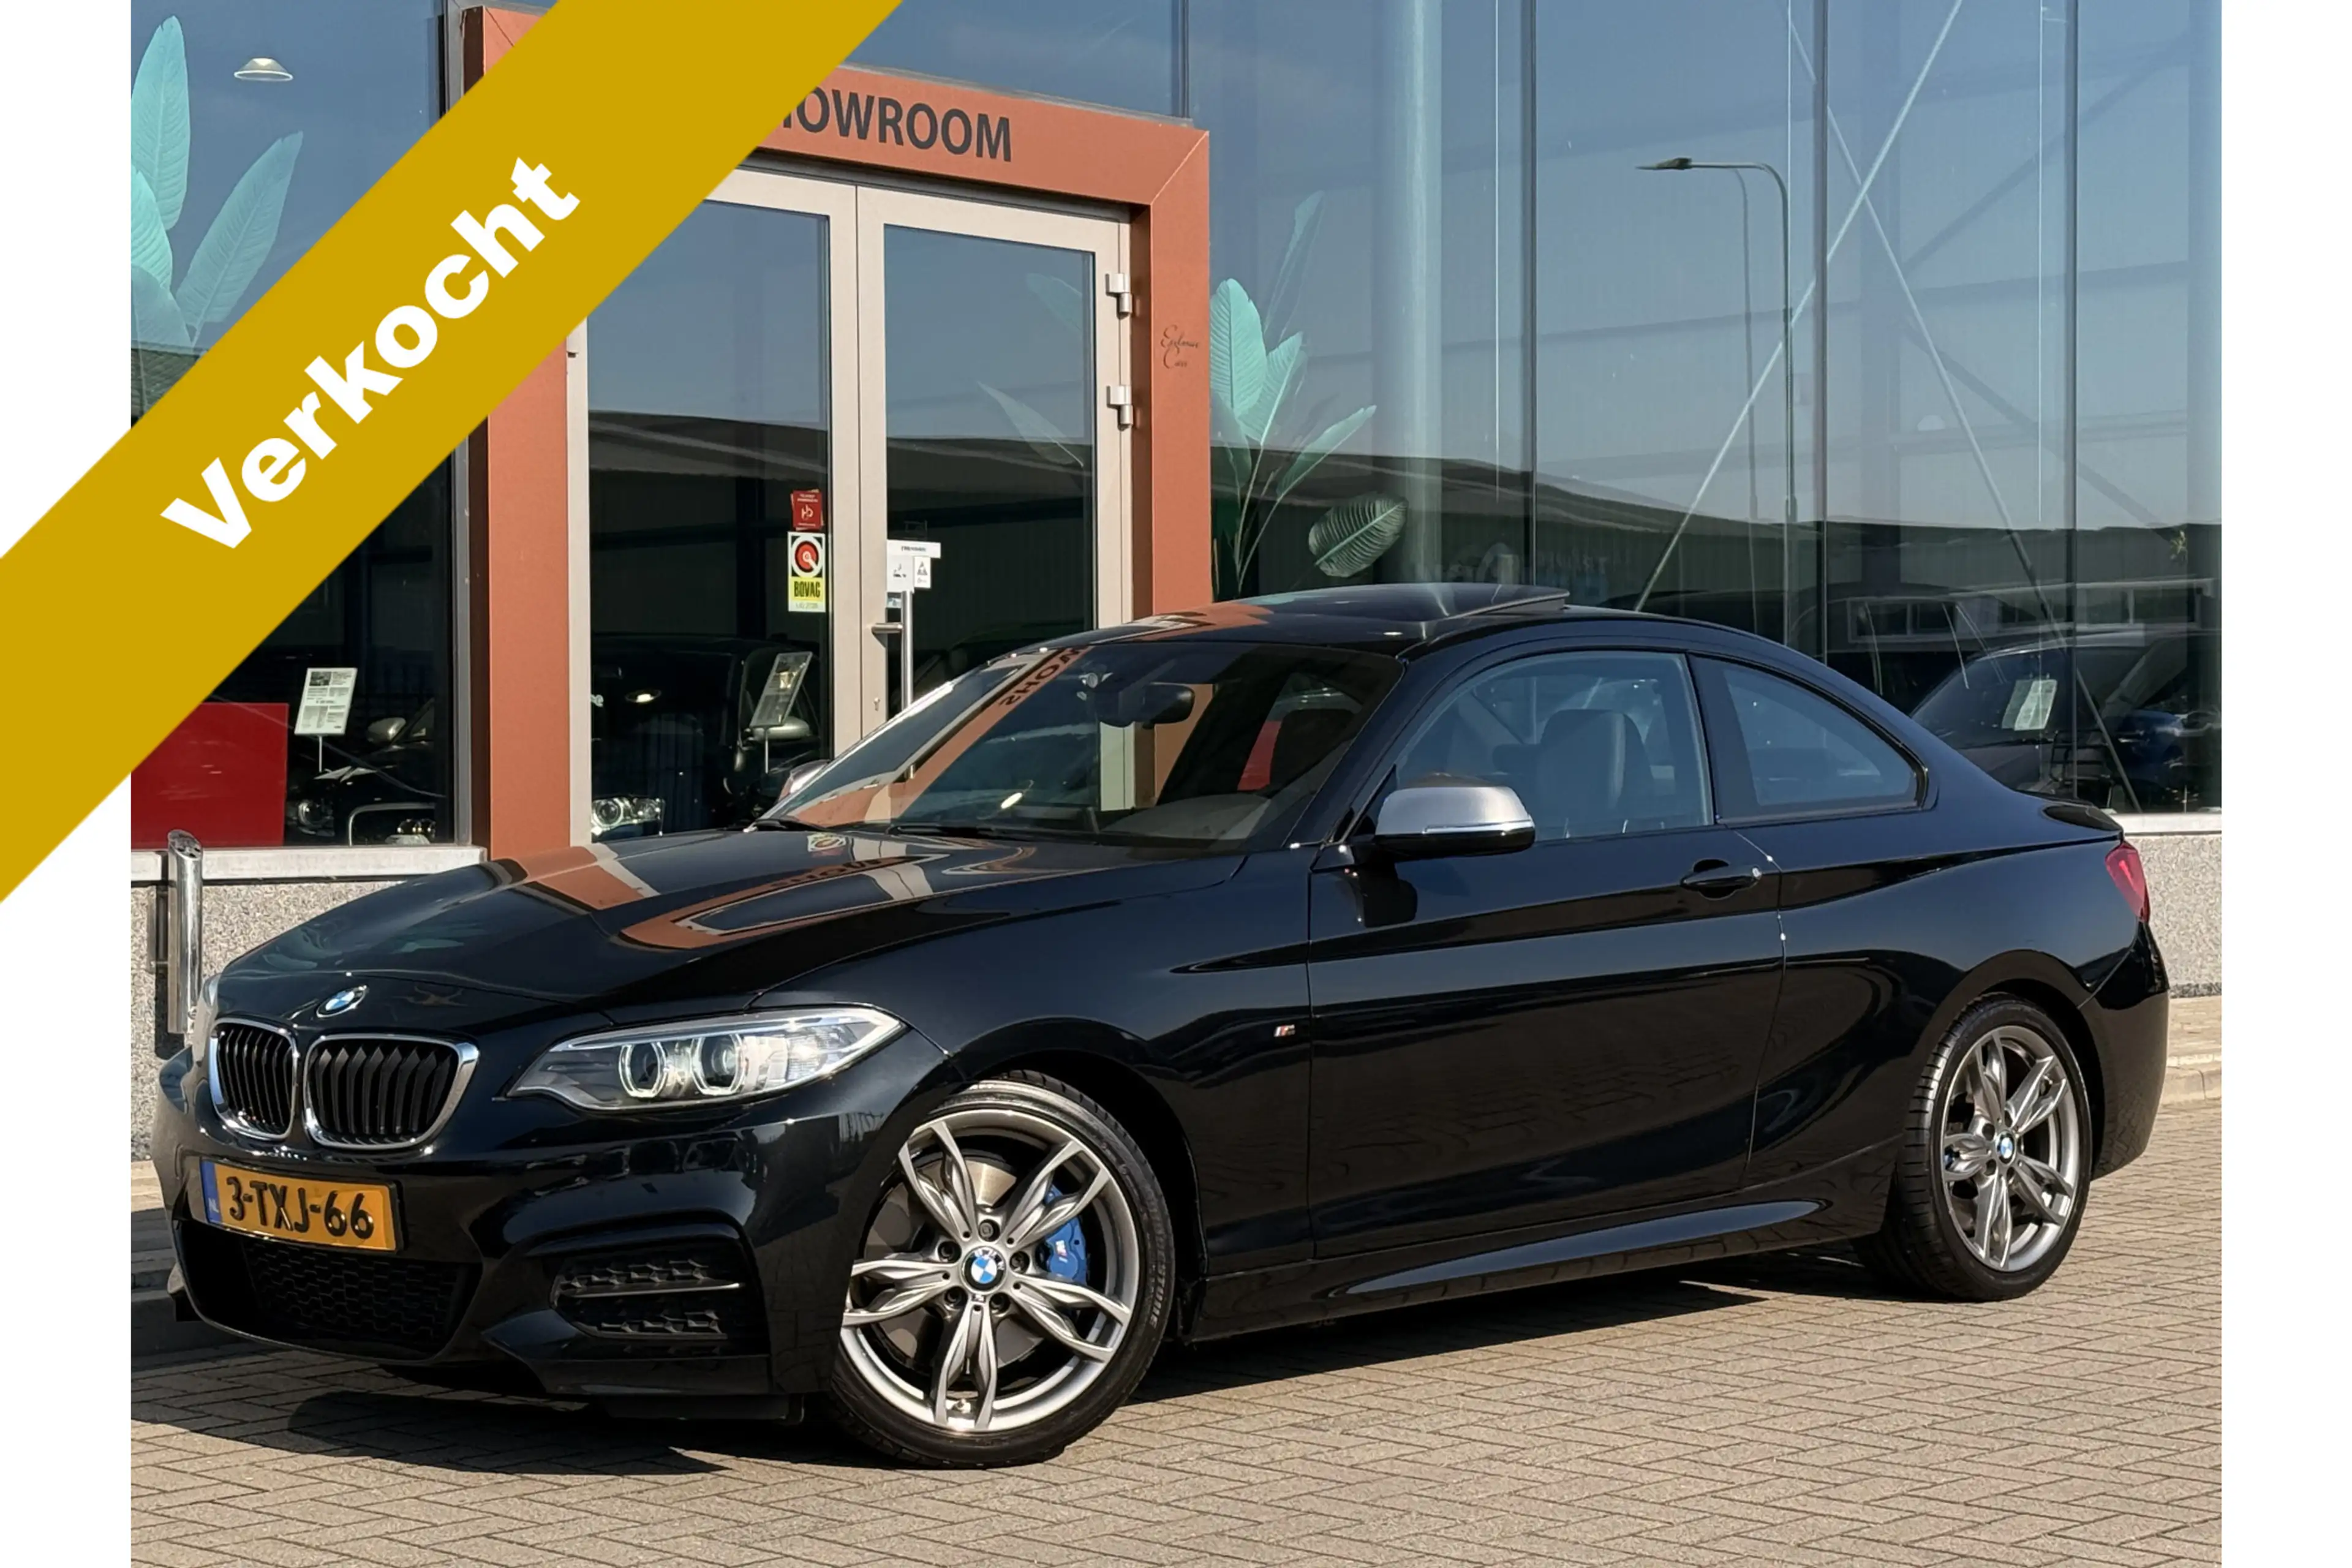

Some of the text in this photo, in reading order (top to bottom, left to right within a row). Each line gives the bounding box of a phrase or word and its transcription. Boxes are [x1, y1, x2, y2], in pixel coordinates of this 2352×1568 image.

[783, 86, 1011, 162] OWROOM
[794, 581, 821, 598] BOVAG
[208, 1197, 219, 1213] NL
[226, 1176, 375, 1240] 3-TXJ-66
